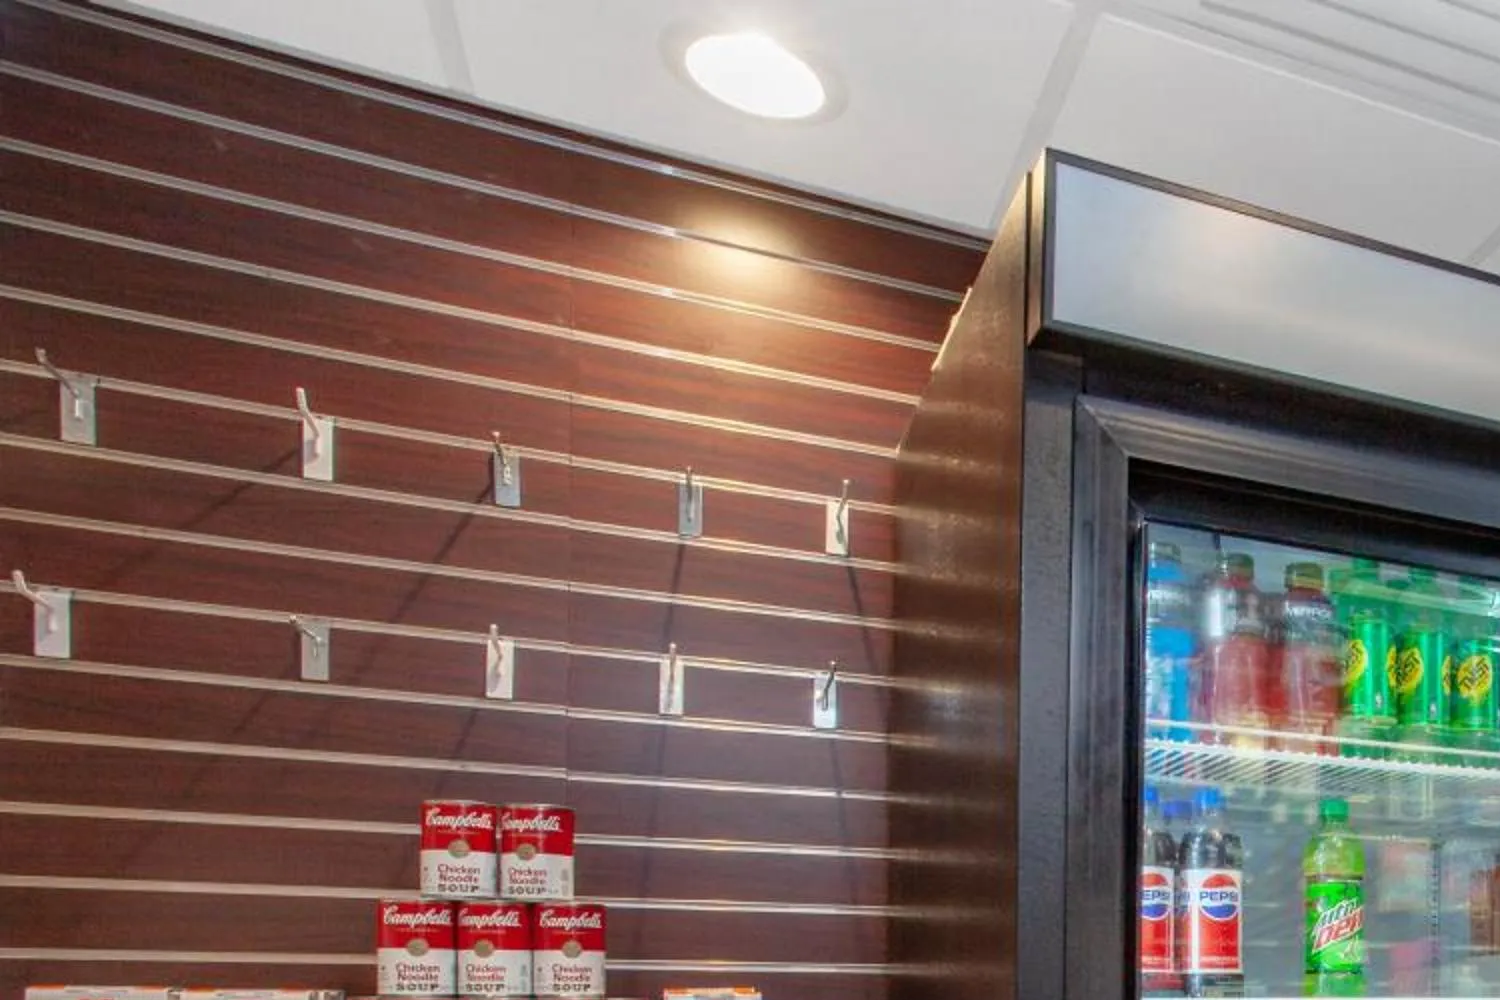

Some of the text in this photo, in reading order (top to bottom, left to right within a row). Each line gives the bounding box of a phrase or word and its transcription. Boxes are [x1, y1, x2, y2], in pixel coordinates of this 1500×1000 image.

[437, 863, 481, 875] Chicken
[438, 884, 480, 893] SOUP
[508, 886, 546, 895] SOUP
[396, 982, 440, 992] SOUP
[466, 983, 506, 992] SOUP
[553, 983, 592, 992] SOUP
